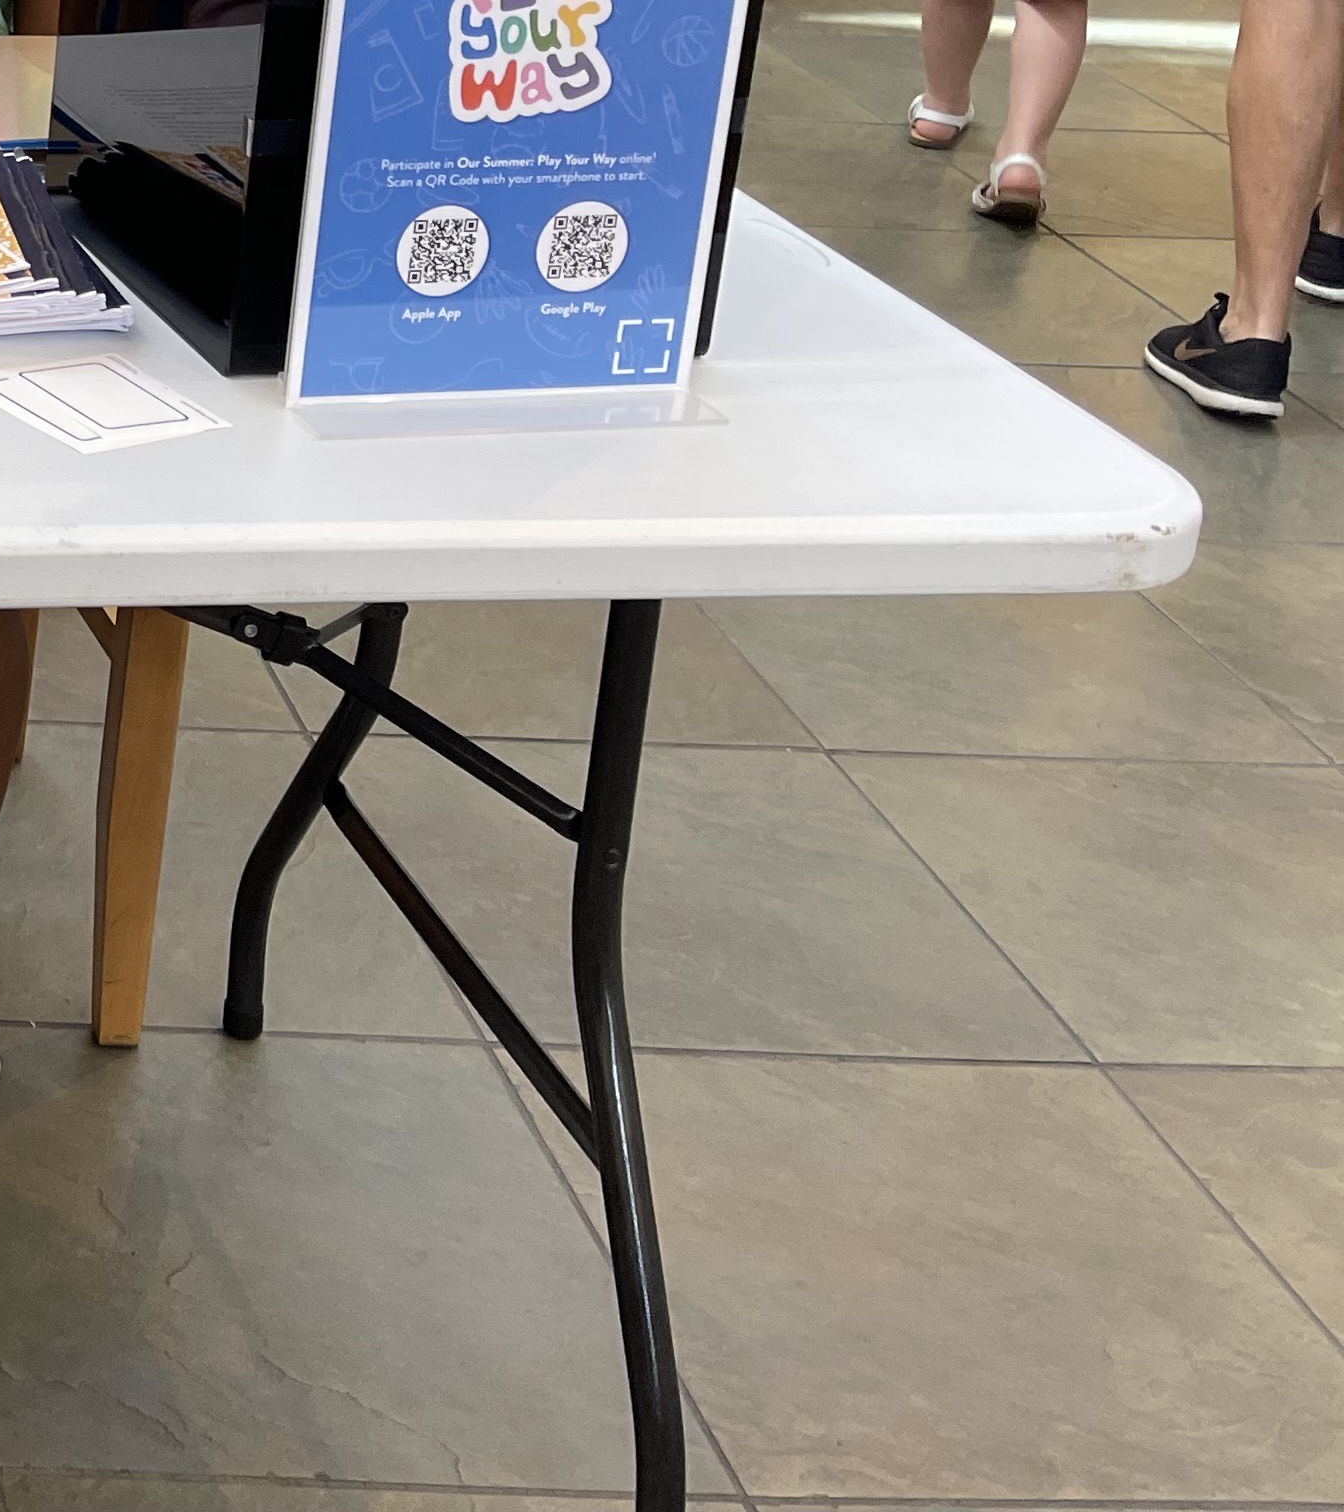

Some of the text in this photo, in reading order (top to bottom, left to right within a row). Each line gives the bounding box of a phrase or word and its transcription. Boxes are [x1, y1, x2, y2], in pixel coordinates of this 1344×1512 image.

[381, 158, 442, 173] Participate
[444, 157, 455, 169] in
[457, 157, 481, 169] Our
[483, 156, 535, 168] Summer:
[537, 155, 563, 170] Play
[564, 154, 590, 166] Your
[592, 153, 617, 167] Way
[387, 171, 647, 188] Scan a QR Code with your smartphone to start.
[401, 308, 462, 323] Apple App
[540, 301, 607, 318] Google Play
